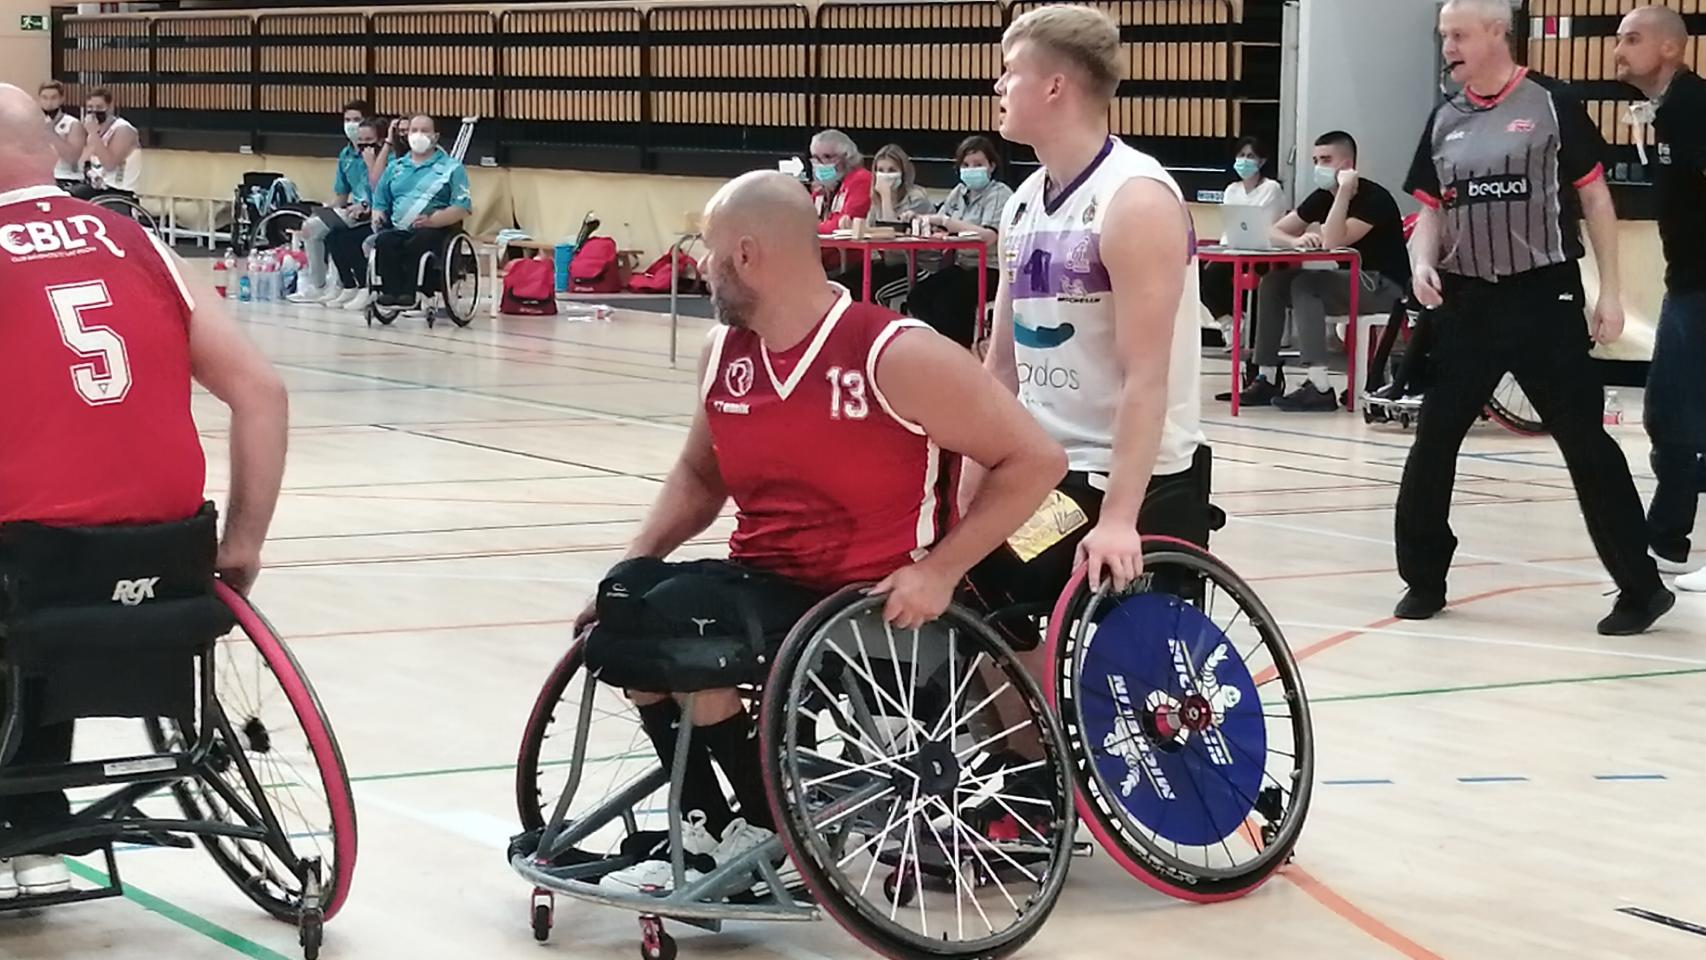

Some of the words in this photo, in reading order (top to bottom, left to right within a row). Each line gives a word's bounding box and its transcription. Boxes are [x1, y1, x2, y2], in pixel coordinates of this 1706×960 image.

[1468, 177, 1527, 198] bequal
[45, 279, 132, 406] 5
[826, 366, 869, 420] 13
[112, 576, 160, 606] RGK
[1111, 674, 1177, 800] MICHELIN
[1167, 639, 1228, 765] MICLIN
